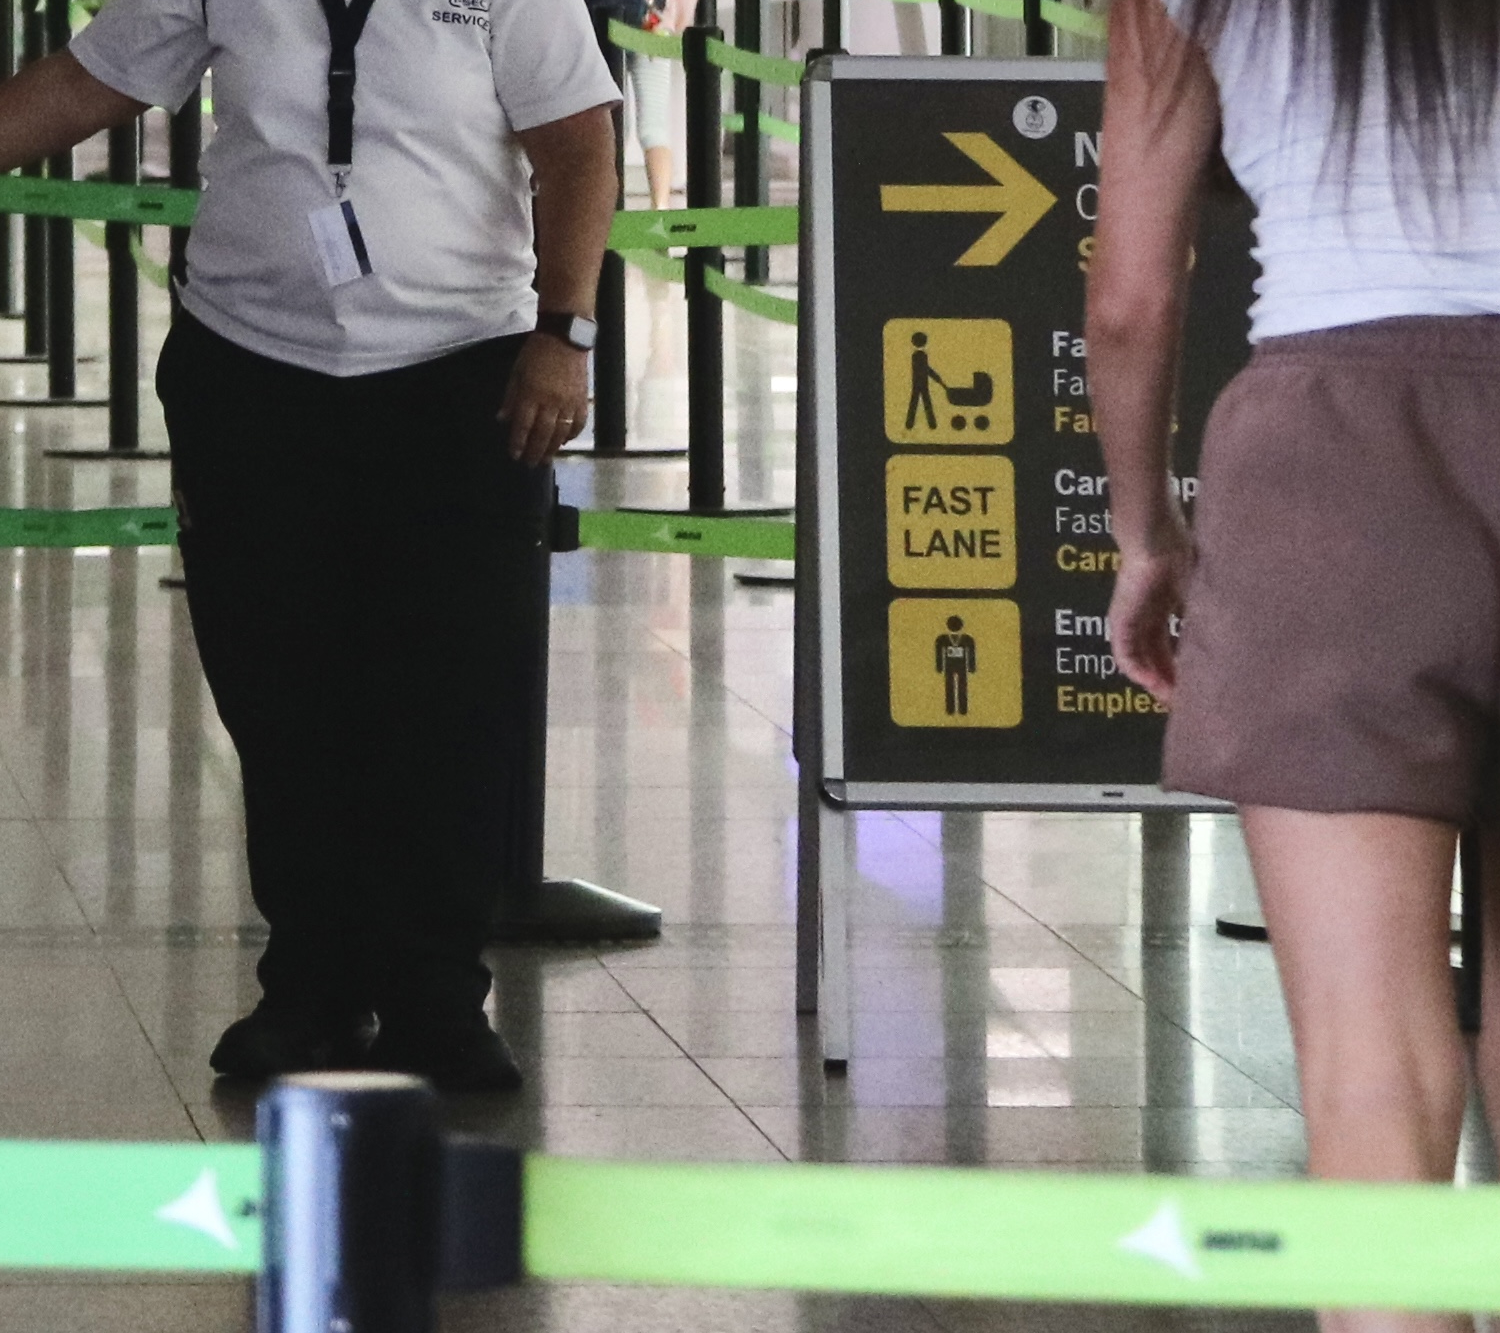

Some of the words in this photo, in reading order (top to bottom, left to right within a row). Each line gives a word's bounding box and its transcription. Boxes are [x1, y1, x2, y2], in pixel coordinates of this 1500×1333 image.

[902, 485, 996, 517] FAST
[1055, 507, 1112, 534] Fast
[903, 528, 1002, 559] LANE
